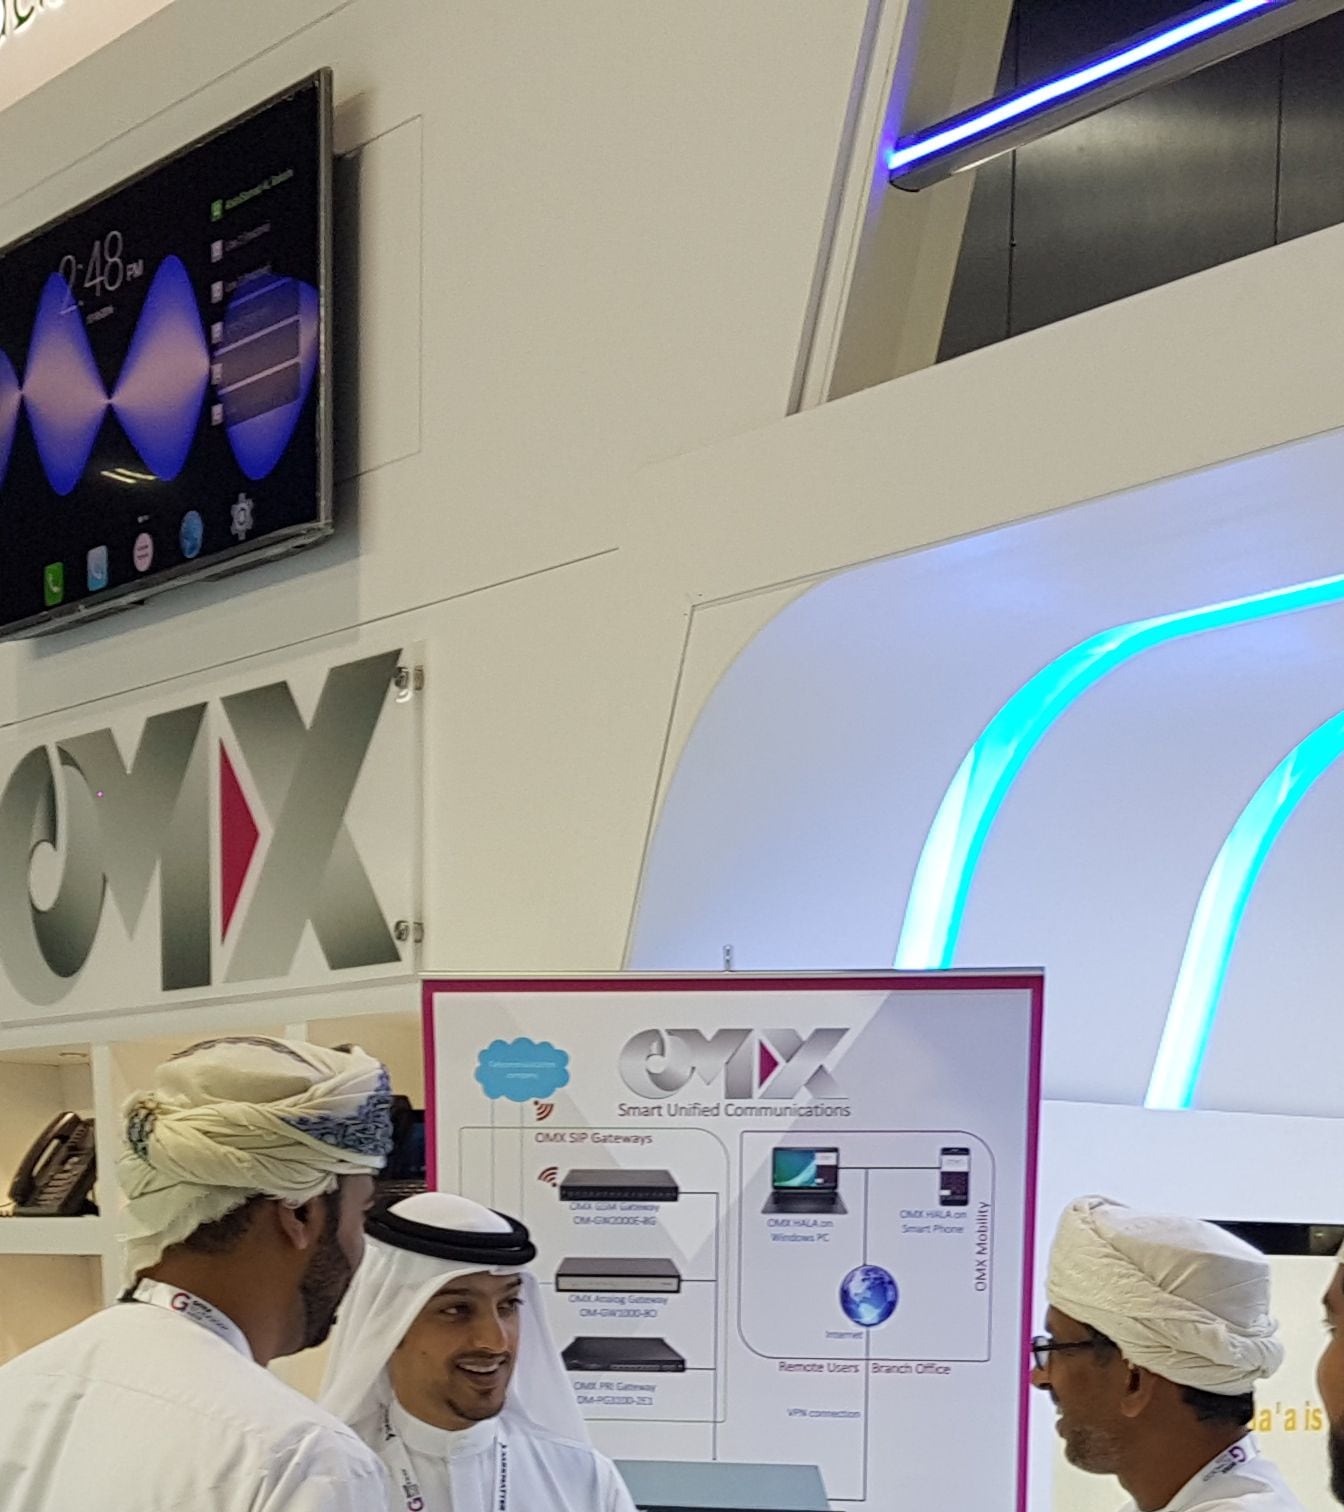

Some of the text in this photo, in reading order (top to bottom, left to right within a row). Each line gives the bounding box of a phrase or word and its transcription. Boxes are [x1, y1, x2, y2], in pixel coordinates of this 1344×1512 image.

[617, 1102, 851, 1118] Smart Unified Communications
[534, 1132, 653, 1146] OMX SIP Gateways
[974, 1201, 992, 1293] OMX Mobility
[778, 1361, 952, 1376] Remote Users Branch Office
